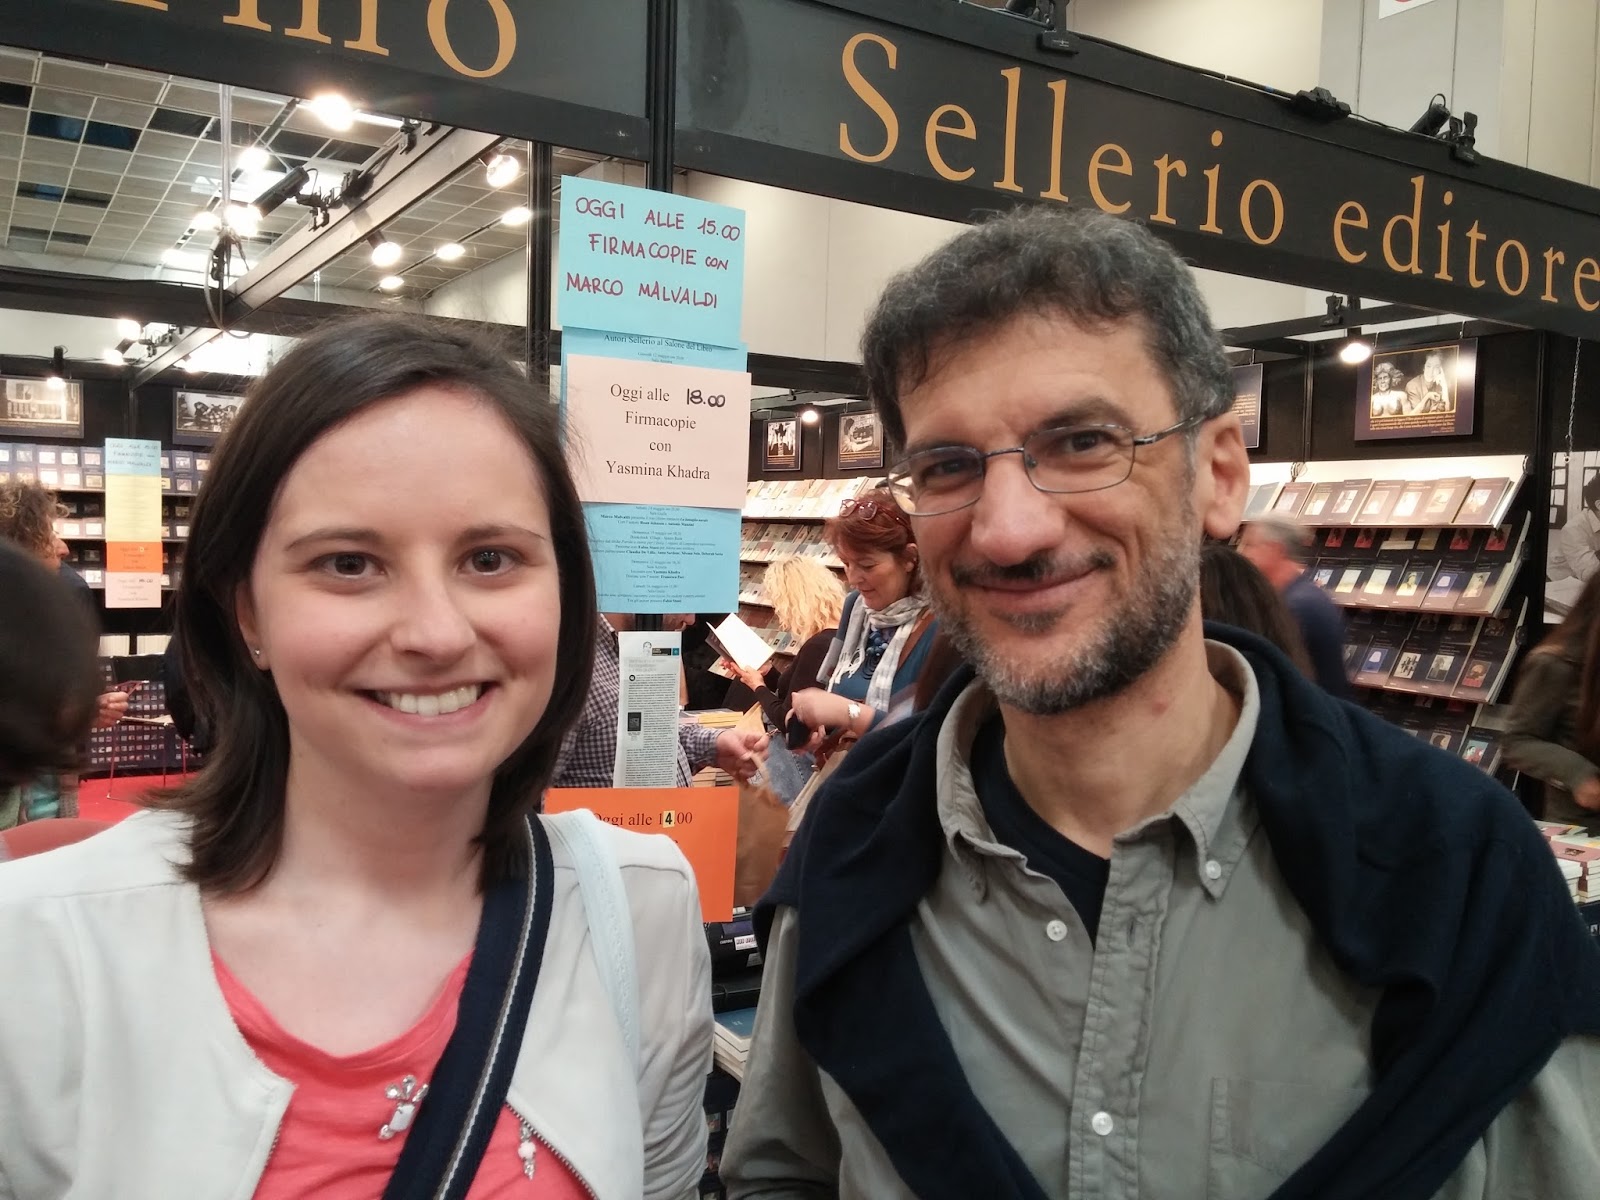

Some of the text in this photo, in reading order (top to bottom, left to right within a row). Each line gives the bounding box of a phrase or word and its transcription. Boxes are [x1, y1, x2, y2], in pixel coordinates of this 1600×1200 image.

[839, 32, 1600, 312] Sellerio editore
[575, 197, 741, 241] OGGI ALLE 15.00
[588, 233, 697, 265] FIRMACOPIE
[566, 272, 717, 308] MARCO MALVALDI
[604, 334, 627, 343] Autori
[629, 336, 655, 345] Sellerio
[610, 384, 726, 408] Oggi alle 18.00
[625, 411, 697, 431] Firmacopie
[649, 441, 672, 452] con
[606, 461, 710, 480] Yasmina Khadra
[628, 813, 653, 825] alle
